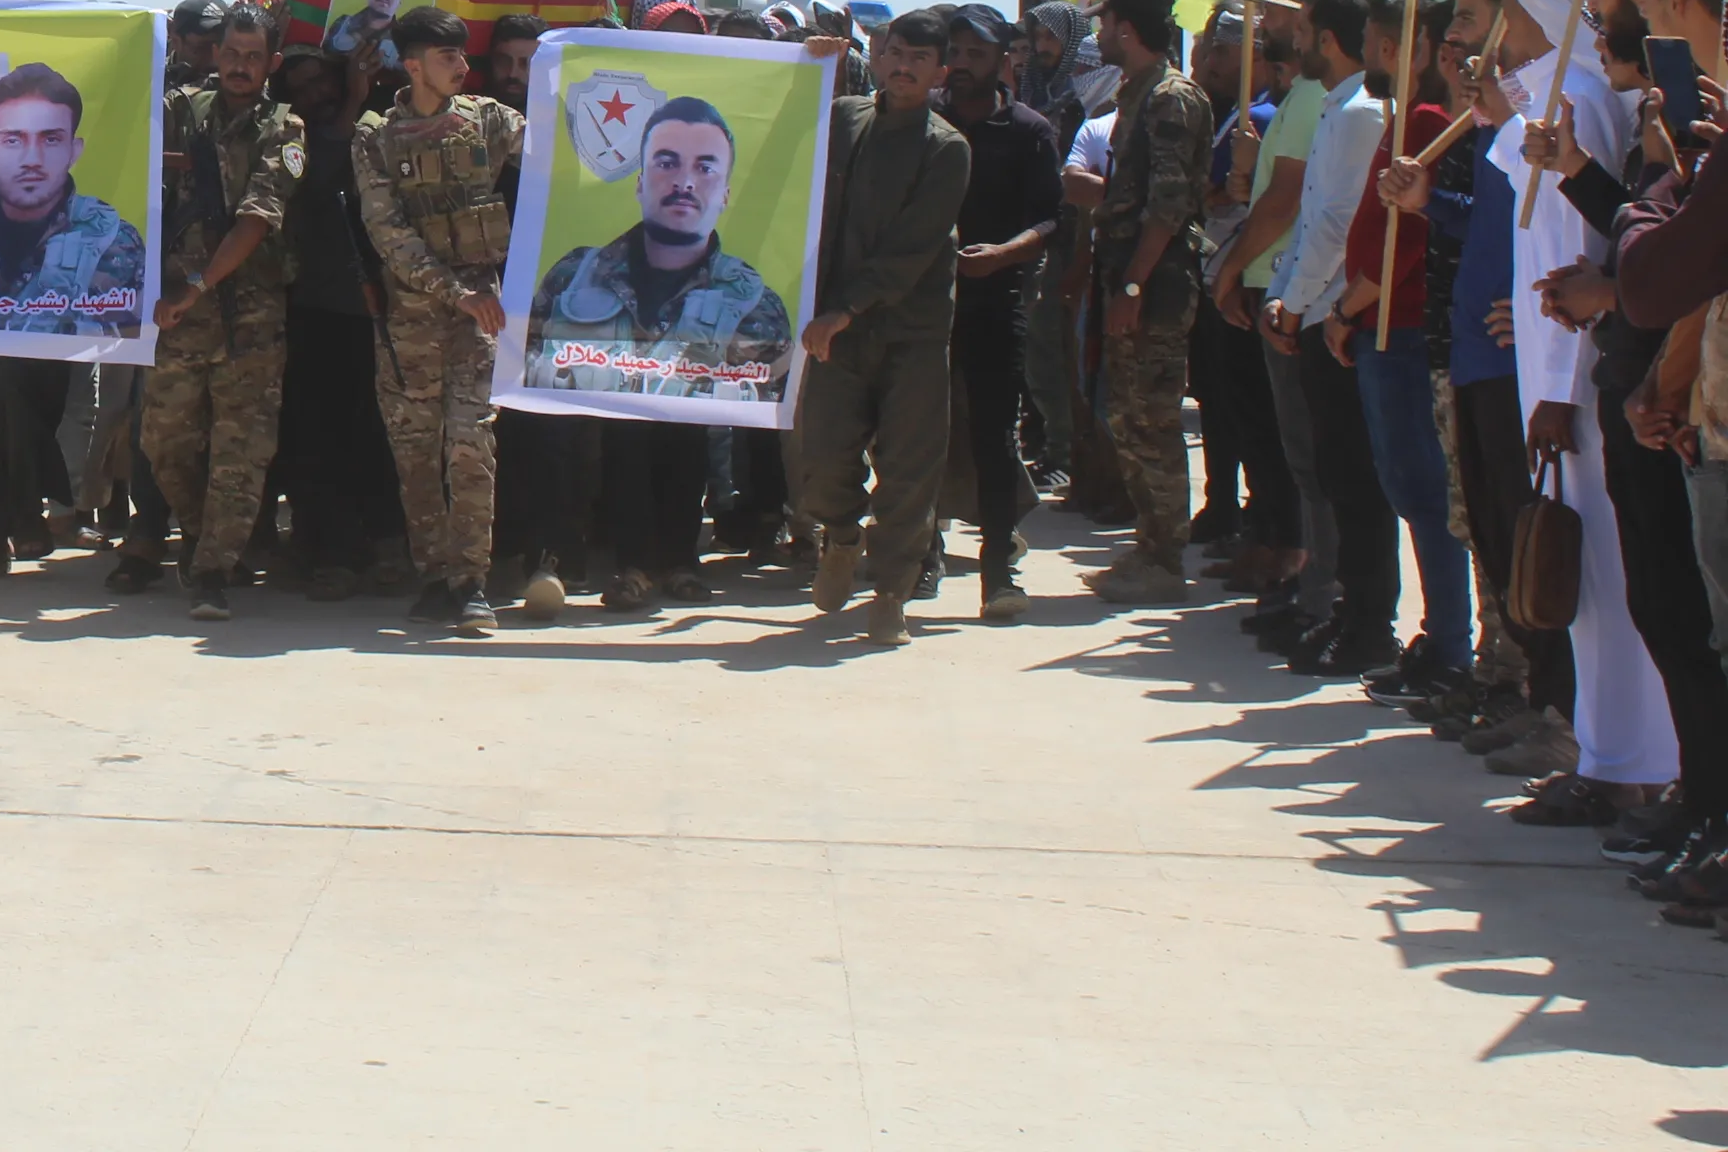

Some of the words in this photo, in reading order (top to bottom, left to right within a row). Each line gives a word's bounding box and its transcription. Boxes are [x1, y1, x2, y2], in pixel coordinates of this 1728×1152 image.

[19, 291, 68, 314] بشير
[73, 289, 135, 314] الشهيد
[555, 344, 608, 366] هلال
[614, 353, 661, 373] حميد
[713, 362, 770, 384] الشهيد
